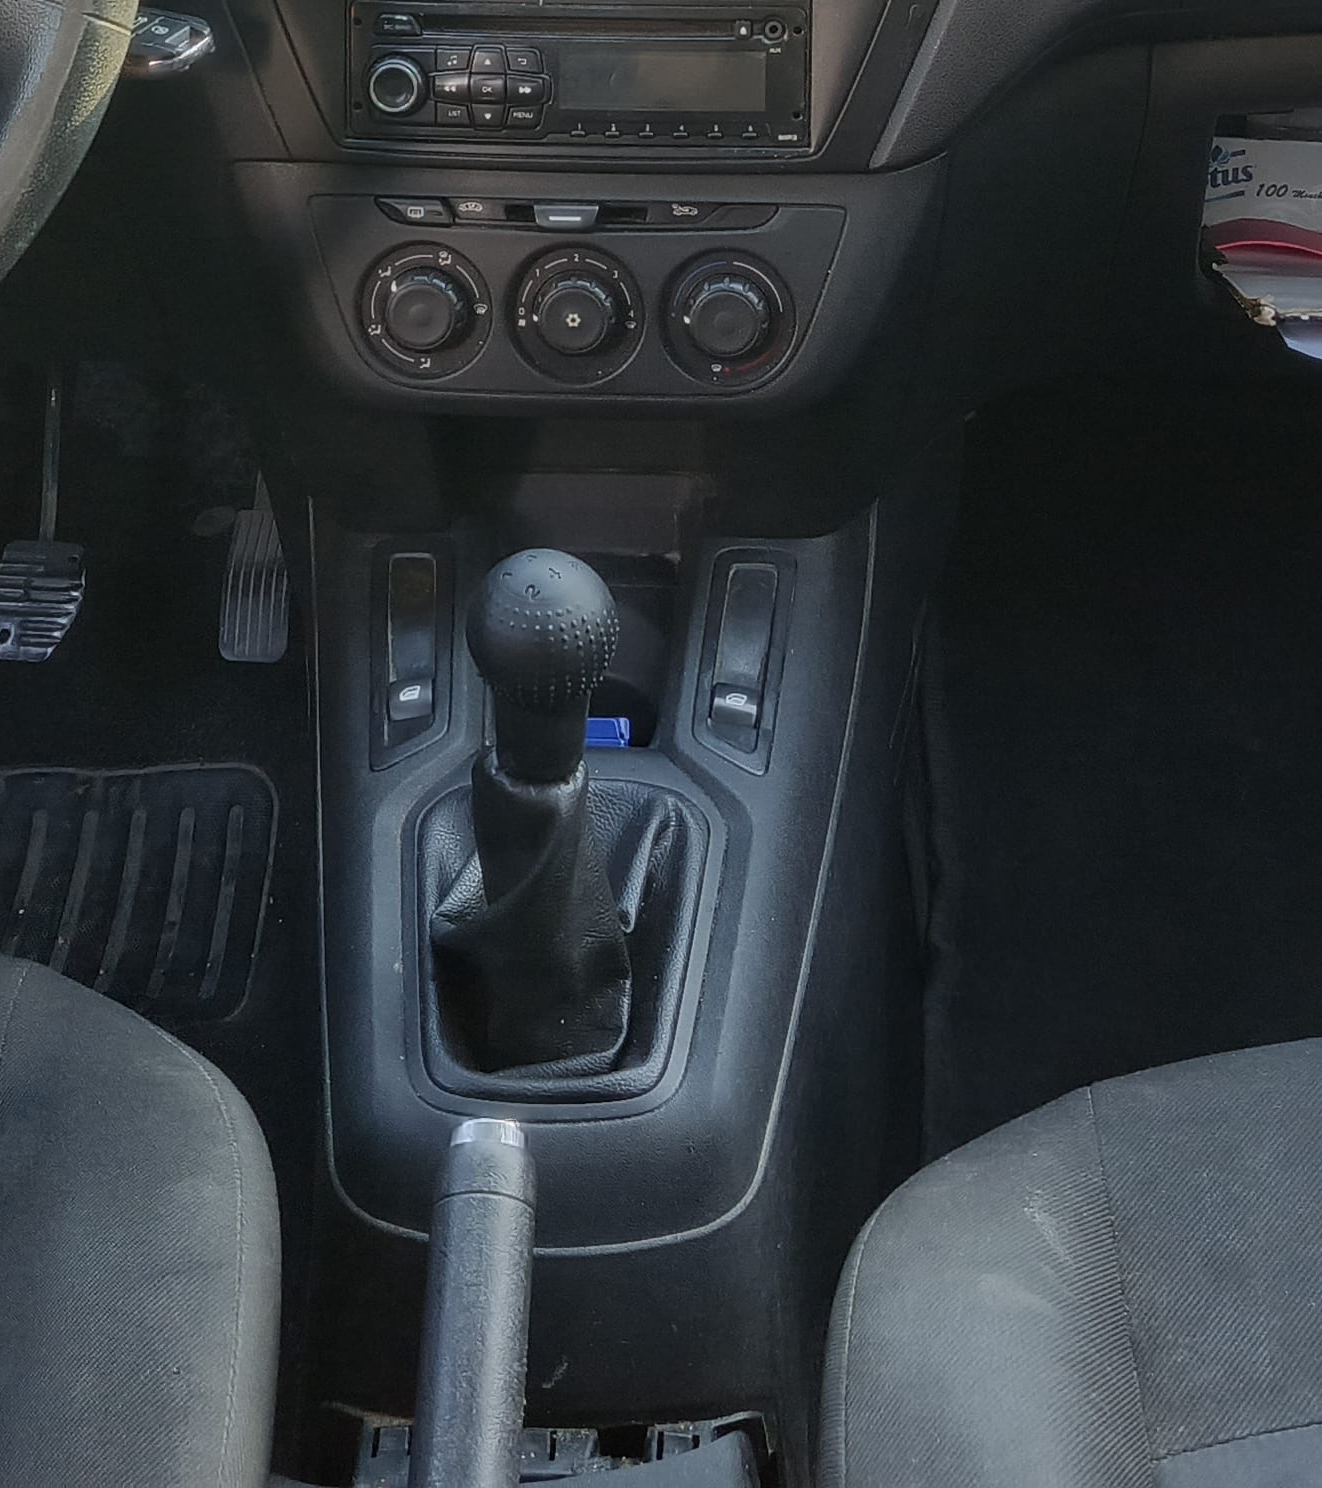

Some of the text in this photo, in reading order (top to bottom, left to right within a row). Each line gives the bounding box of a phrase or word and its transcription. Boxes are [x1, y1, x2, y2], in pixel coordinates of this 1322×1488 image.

[512, 111, 534, 119] MENU
[1208, 164, 1254, 189] tus
[1255, 183, 1289, 198] 100
[573, 253, 579, 262] 2
